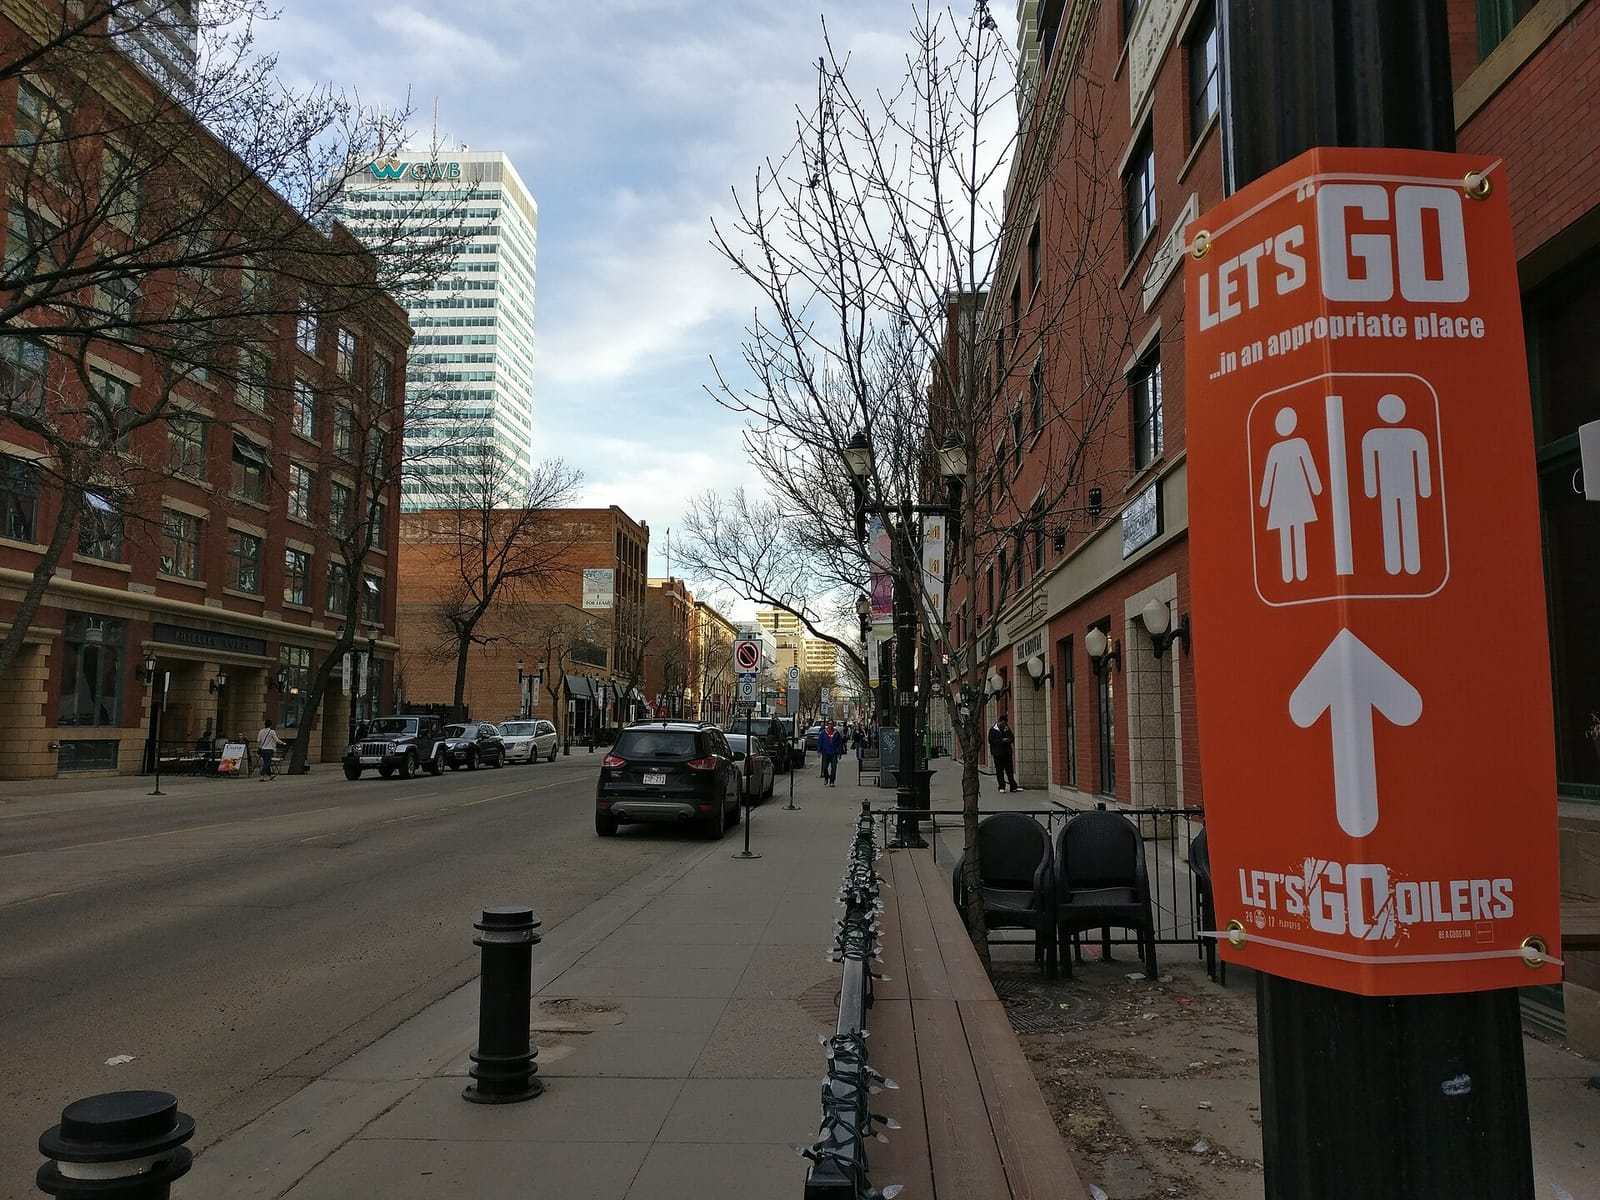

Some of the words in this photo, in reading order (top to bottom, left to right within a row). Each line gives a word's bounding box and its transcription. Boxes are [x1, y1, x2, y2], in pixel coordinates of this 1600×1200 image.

[410, 162, 461, 180] CWB
[1199, 224, 1306, 332] LET'S
[1241, 341, 1263, 367] an
[1268, 312, 1407, 355] appropriate
[1414, 312, 1485, 340] place
[1239, 868, 1304, 916] LET'S
[1304, 858, 1396, 941] GO
[1396, 878, 1514, 925] OILERS
[1268, 916, 1275, 928] 17
